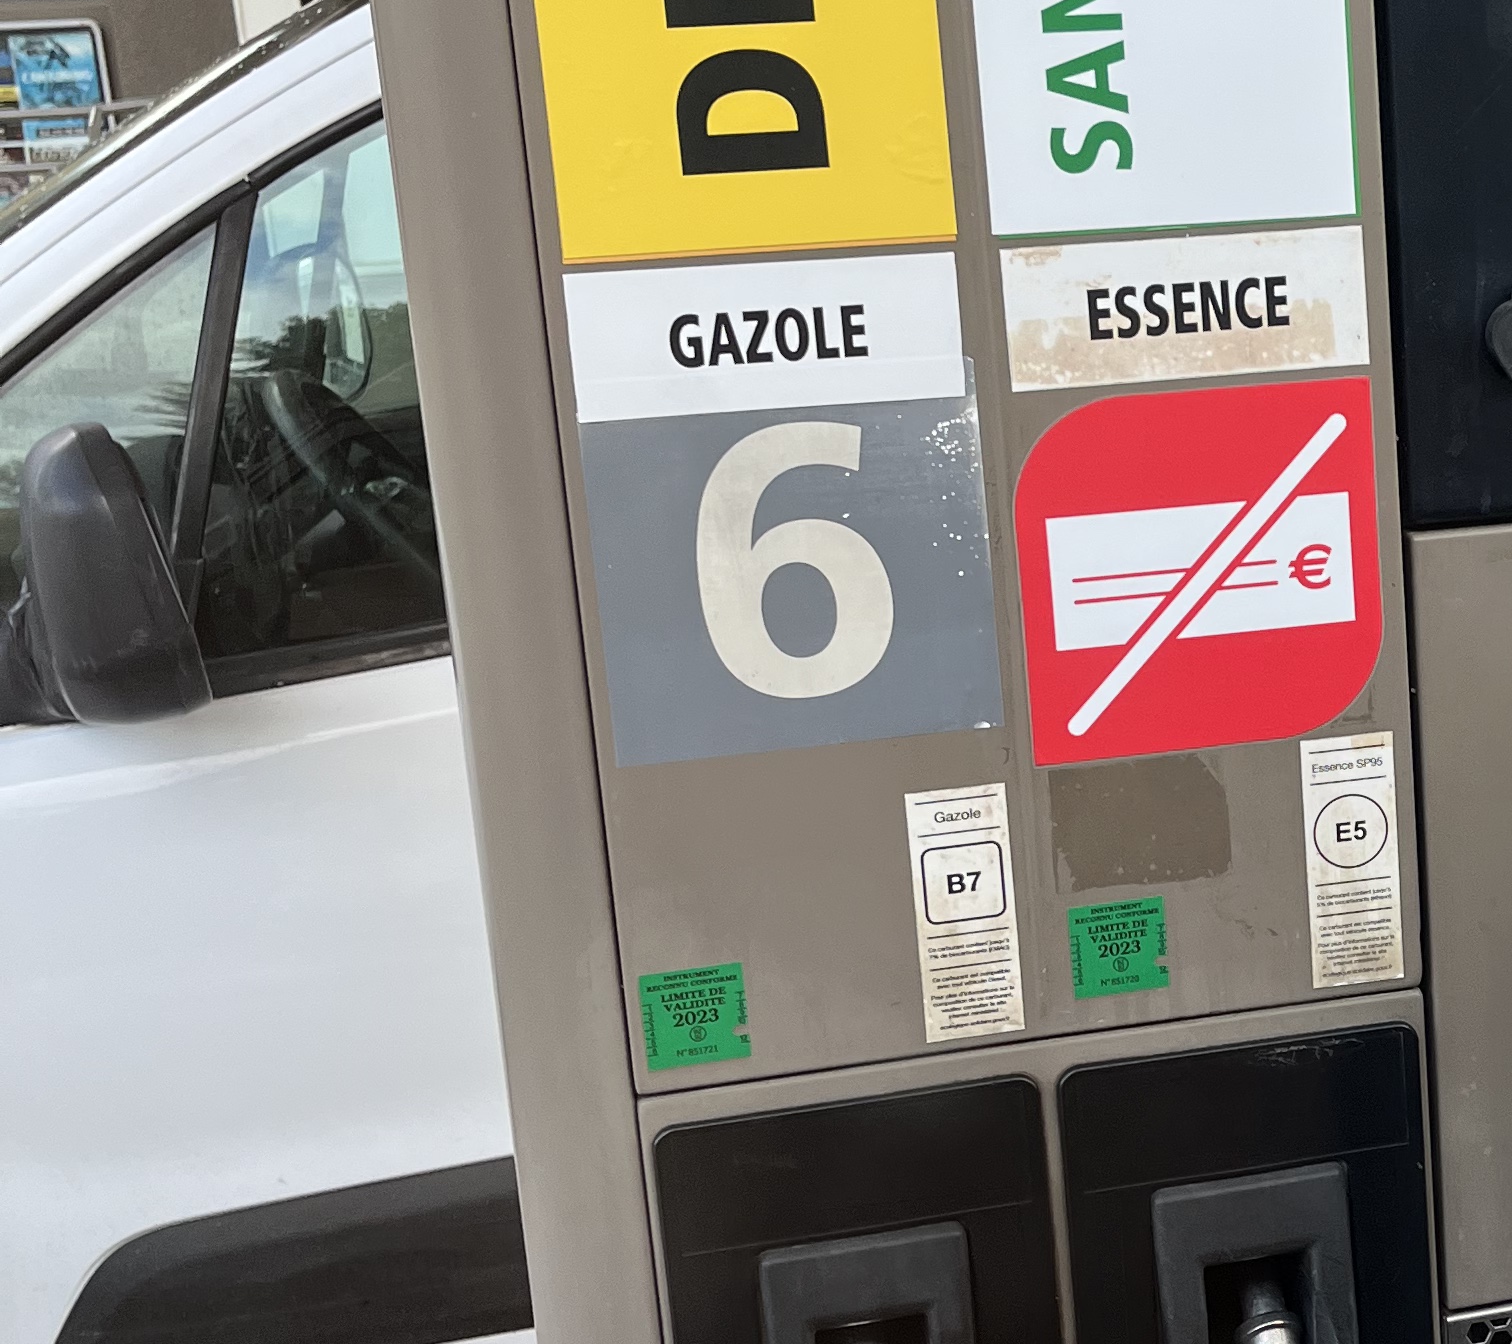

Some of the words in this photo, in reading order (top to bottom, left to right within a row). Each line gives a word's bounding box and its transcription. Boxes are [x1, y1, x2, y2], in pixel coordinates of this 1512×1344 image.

[1088, 275, 1291, 342] ESSENCE
[668, 304, 869, 370] GAZOLE
[696, 420, 895, 699] 6
[1312, 761, 1354, 774] Essence
[1356, 757, 1383, 769] SP95
[934, 808, 981, 823] Gazole
[1336, 820, 1367, 842] E5
[947, 871, 982, 895] B7
[1091, 902, 1142, 914] INSTRUMENT
[1087, 922, 1130, 934] LIMITE
[1132, 919, 1148, 928] DE
[1090, 928, 1147, 943] VALIDITE
[1098, 940, 1141, 958] 2023
[663, 969, 720, 982] INSTRUMENT
[660, 989, 706, 1003] LIMITE
[709, 987, 726, 996] DE
[664, 997, 726, 1012] VALIDITE
[672, 1008, 719, 1027] 2023
